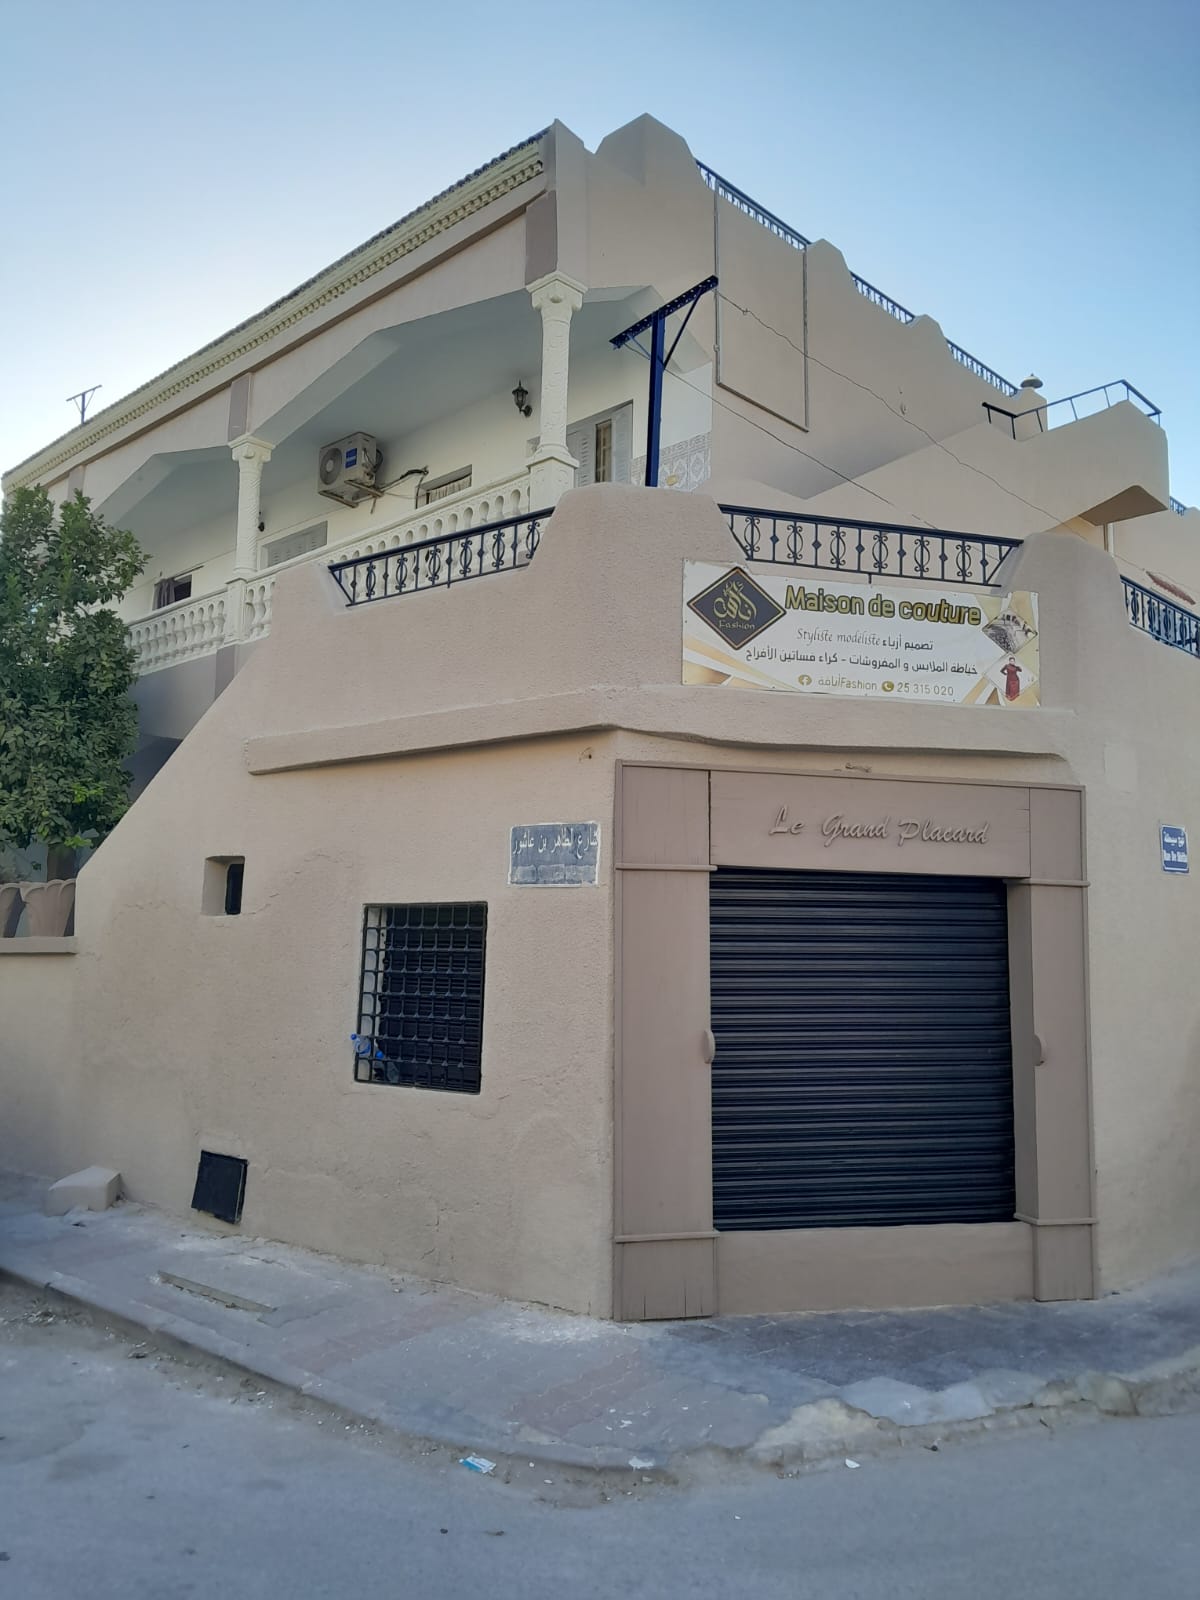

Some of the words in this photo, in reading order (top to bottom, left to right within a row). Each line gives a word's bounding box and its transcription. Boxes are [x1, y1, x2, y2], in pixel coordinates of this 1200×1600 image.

[785, 585, 865, 615] Maison
[868, 593, 895, 619] de
[899, 599, 981, 626] couture
[719, 620, 756, 630] Fashion
[797, 627, 833, 646] Styliste
[882, 634, 902, 650] أزياء
[746, 645, 777, 661] الأفراح
[904, 640, 934, 651] تصميم
[818, 651, 838, 665] كراء
[849, 654, 901, 670] المفروشات
[903, 662, 909, 672] و
[911, 660, 948, 673] الملابس
[897, 682, 910, 693] 25
[913, 683, 931, 694] 315
[934, 685, 954, 696] 020
[768, 804, 806, 837] Le
[821, 814, 891, 848] Grand
[897, 818, 990, 847] Placard
[512, 829, 535, 855] عاشور
[538, 834, 547, 854] بن
[576, 826, 598, 860] شارع
